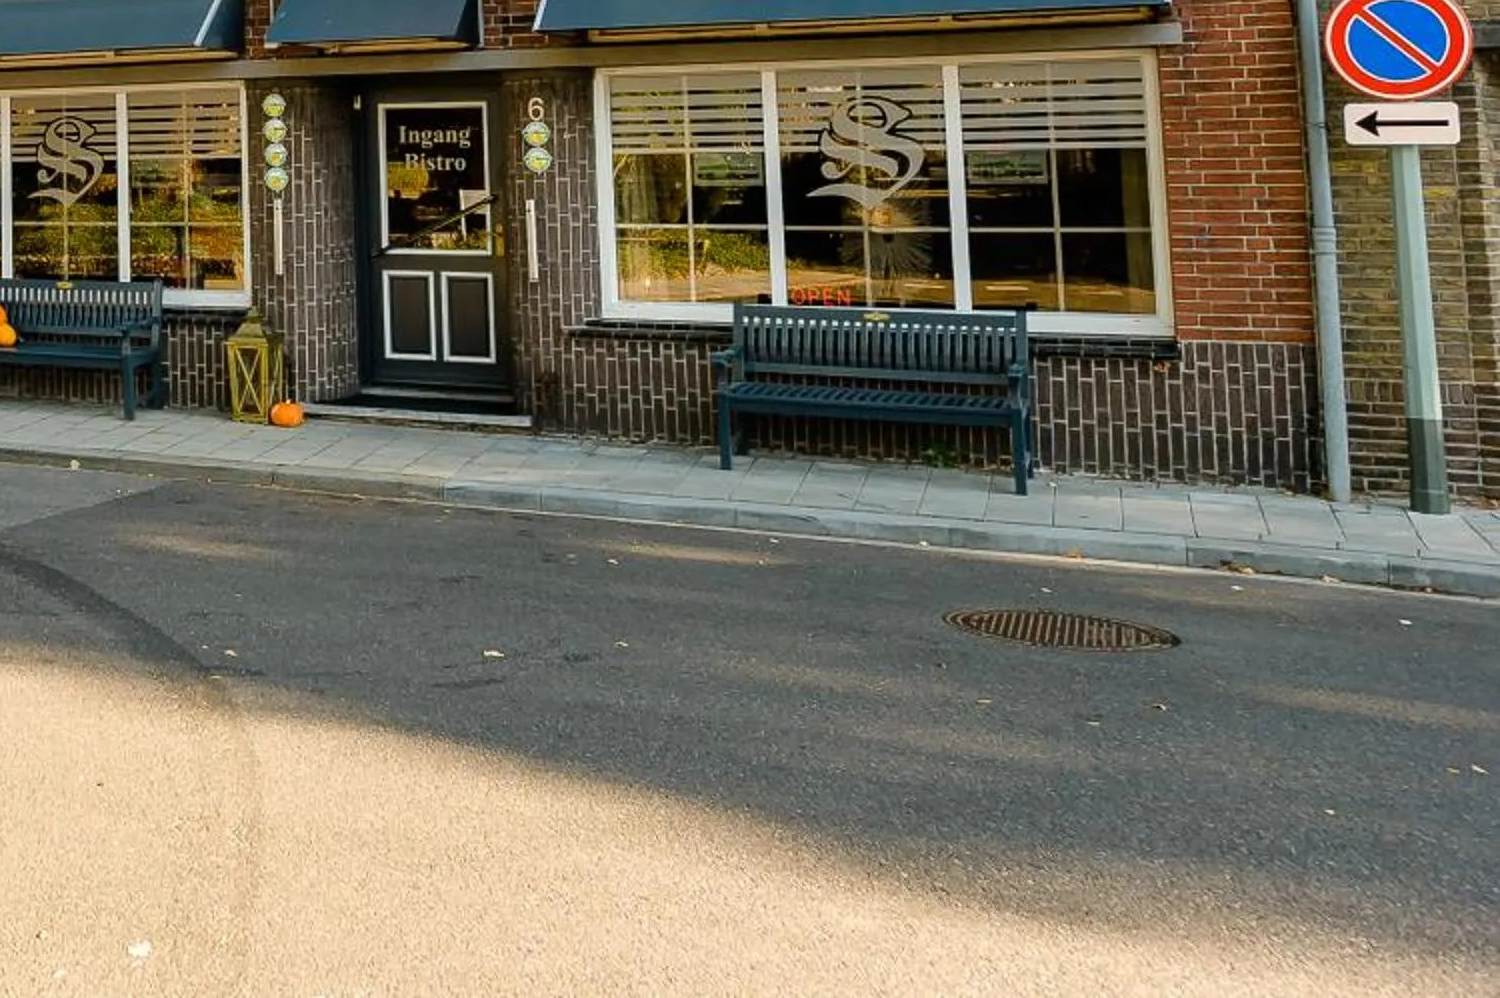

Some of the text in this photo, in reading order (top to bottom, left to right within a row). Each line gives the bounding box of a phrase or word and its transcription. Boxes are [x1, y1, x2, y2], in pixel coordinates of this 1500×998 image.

[527, 97, 545, 121] 6
[399, 125, 472, 148] Ingang
[404, 152, 467, 172] Bistro
[790, 284, 851, 308] OPEN
